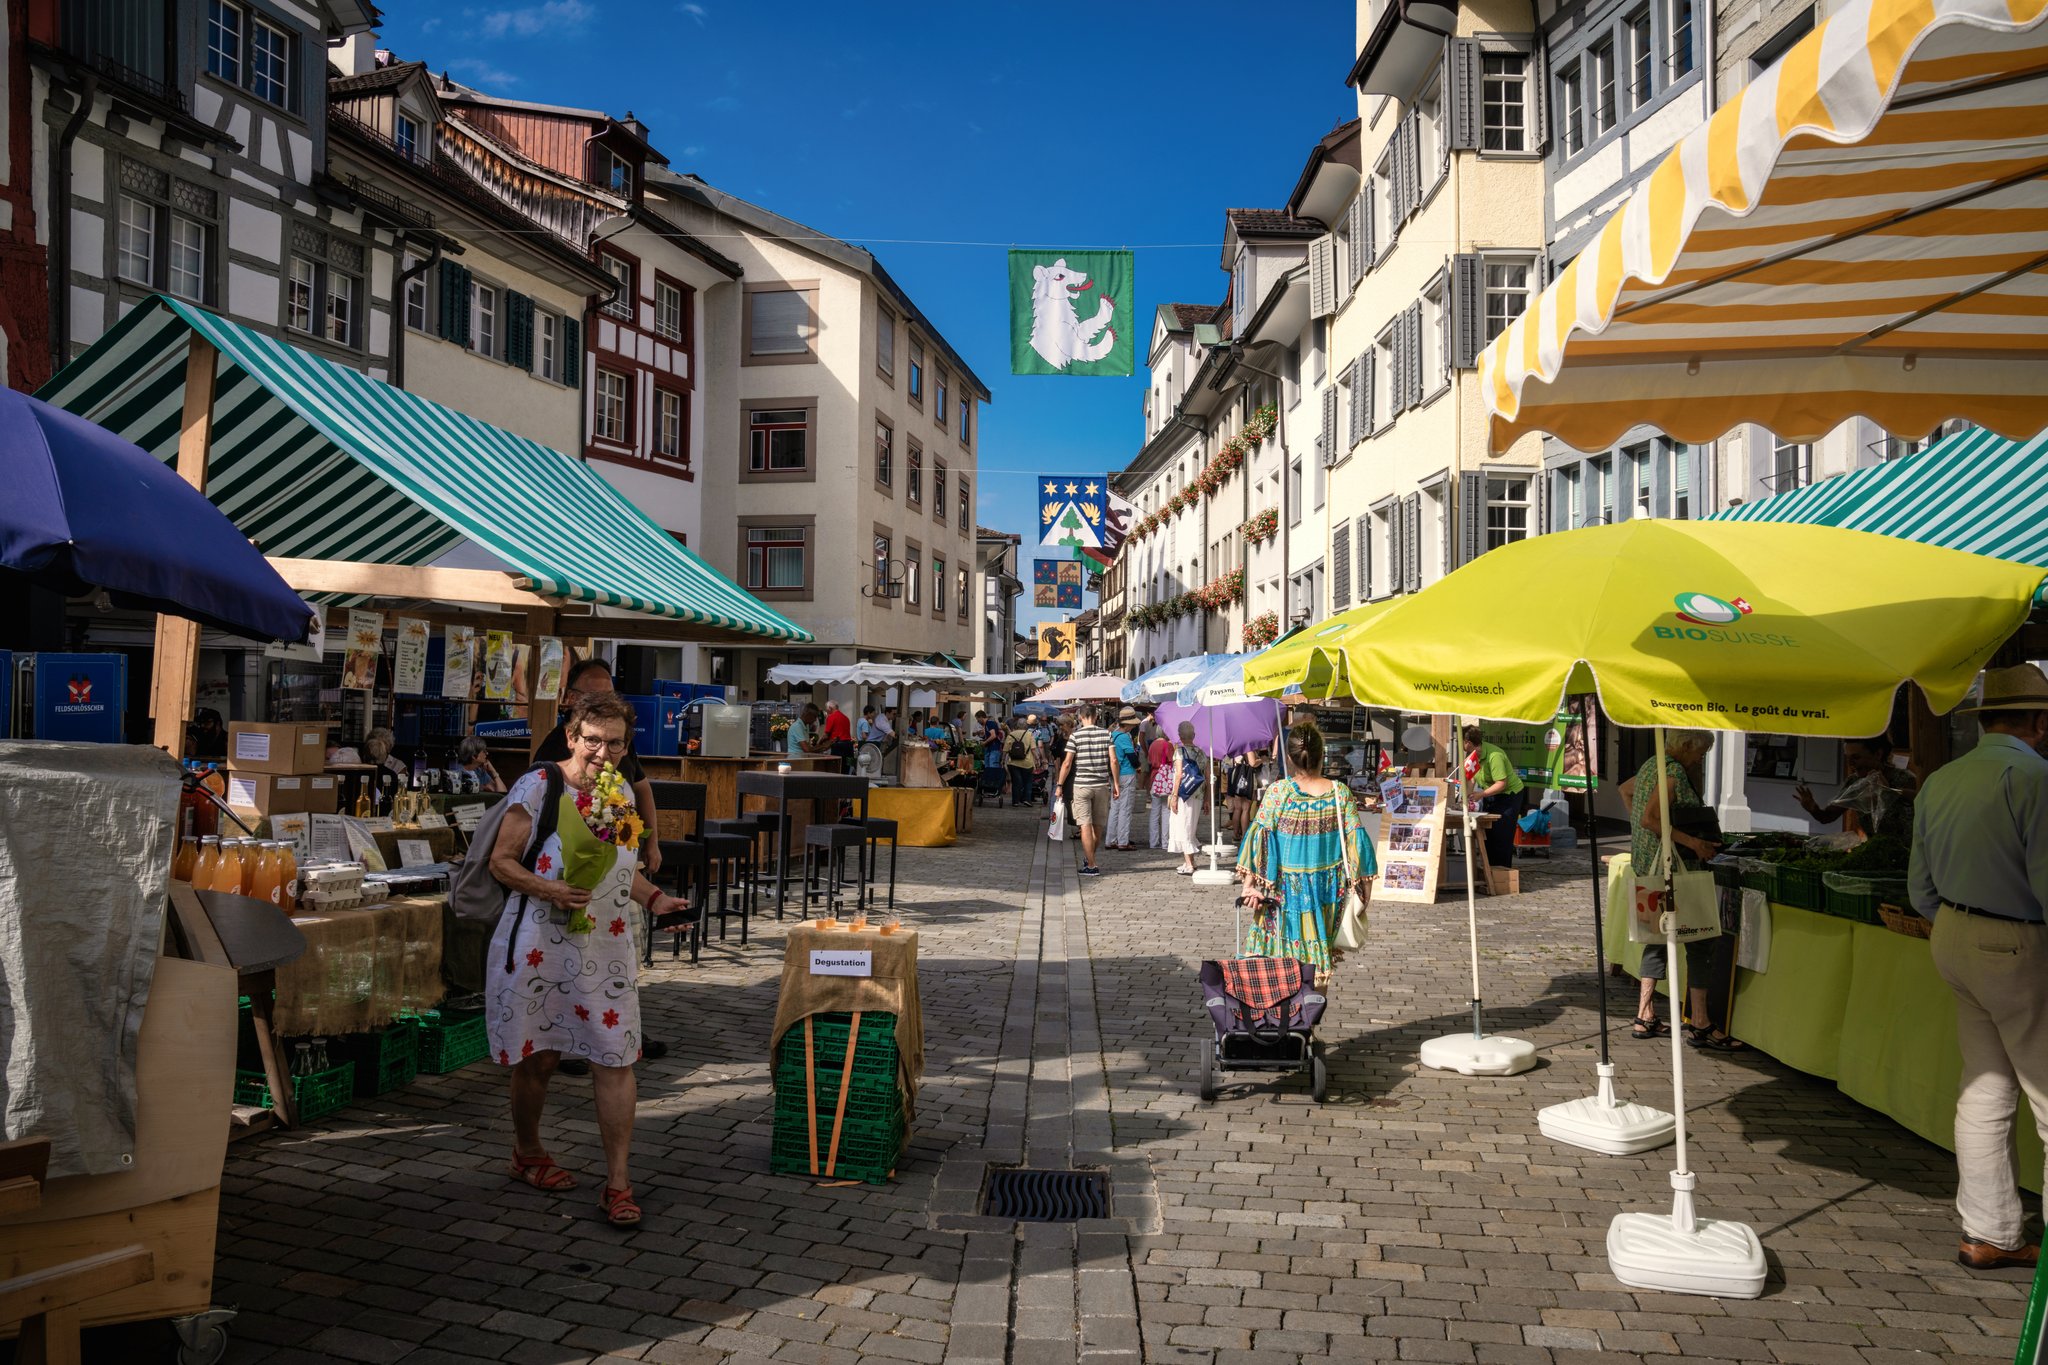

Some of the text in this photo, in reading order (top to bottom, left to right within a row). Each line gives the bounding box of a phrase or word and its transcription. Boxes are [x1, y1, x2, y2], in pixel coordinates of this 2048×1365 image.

[1209, 687, 1235, 696] Paysans
[1413, 680, 1505, 696] www.bio-suisse.ch
[55, 704, 104, 713] FELDSCHLÖSSCHEN
[1650, 699, 1830, 719] Bourgeon Bio. Le goût du vrai.
[815, 959, 866, 967] Degustation
